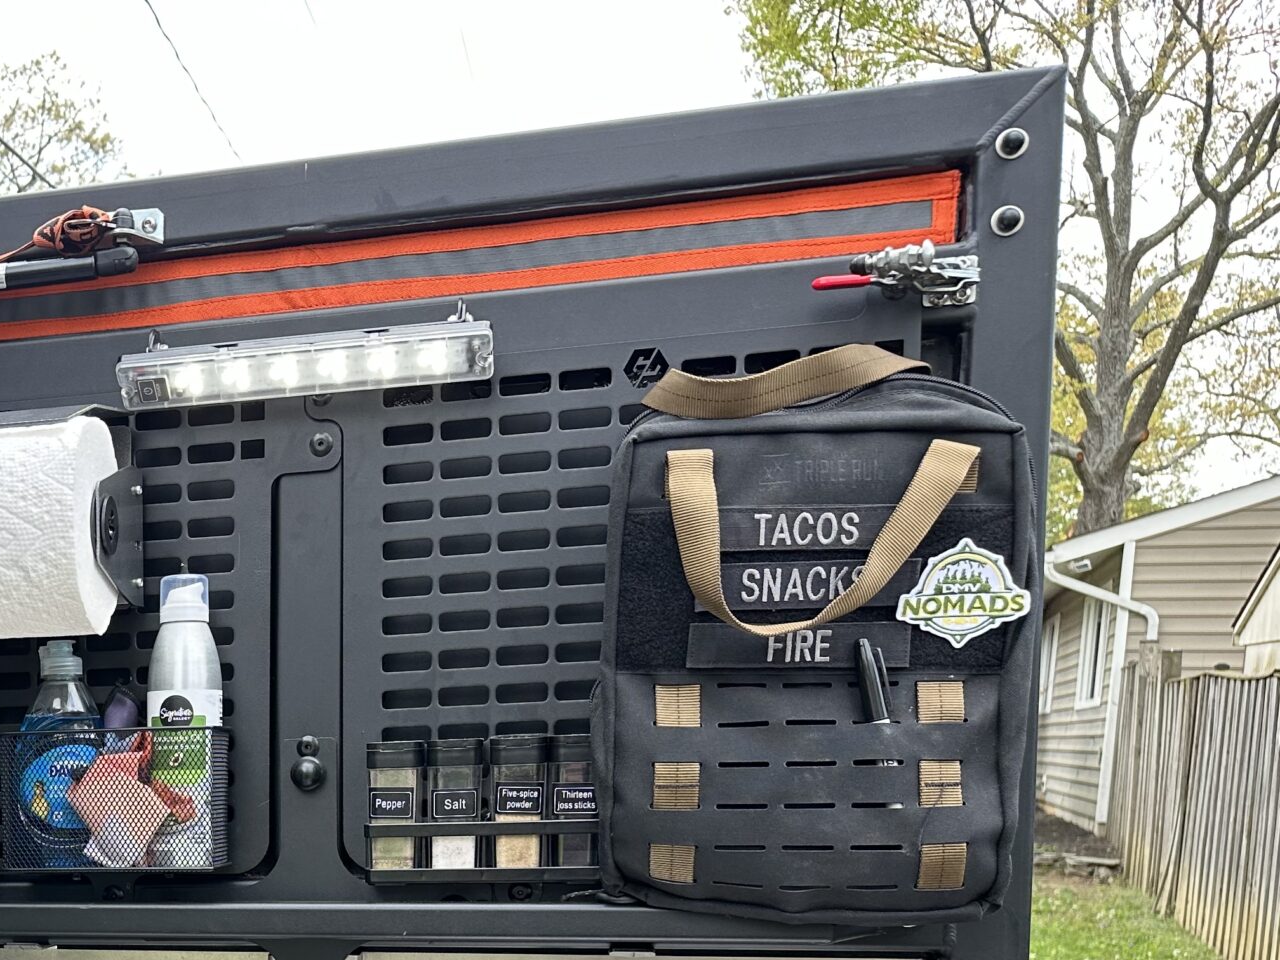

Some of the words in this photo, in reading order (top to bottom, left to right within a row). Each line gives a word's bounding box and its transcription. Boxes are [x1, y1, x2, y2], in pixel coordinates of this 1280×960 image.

[754, 511, 860, 546] TACOS
[942, 583, 981, 593] DMV
[901, 594, 1025, 617] NOMADS
[766, 629, 833, 662] FIRE
[501, 788, 539, 799] Five-spice
[561, 789, 593, 799] Thirteen
[375, 798, 406, 811] Pepper
[444, 798, 467, 810] Salt
[506, 800, 533, 810] powder
[556, 800, 573, 811] joss
[574, 800, 596, 809] sticks
